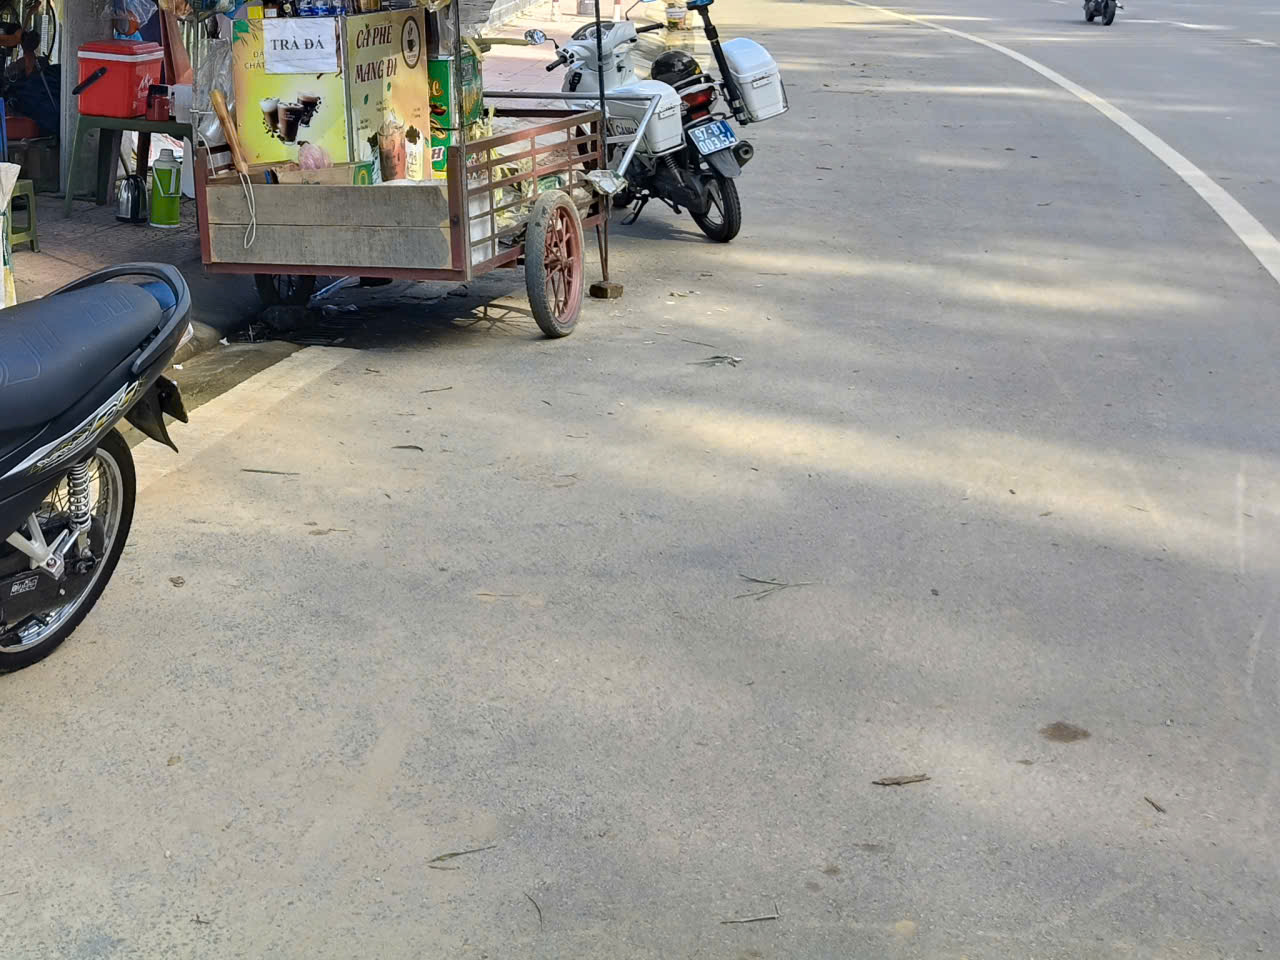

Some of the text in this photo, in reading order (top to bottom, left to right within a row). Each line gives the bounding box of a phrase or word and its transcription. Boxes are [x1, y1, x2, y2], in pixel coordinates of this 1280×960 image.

[270, 34, 325, 51] TRÀ ĐÁ
[355, 59, 385, 84] MANG
[694, 122, 726, 141] 97-B1
[698, 131, 736, 154] 003.54
